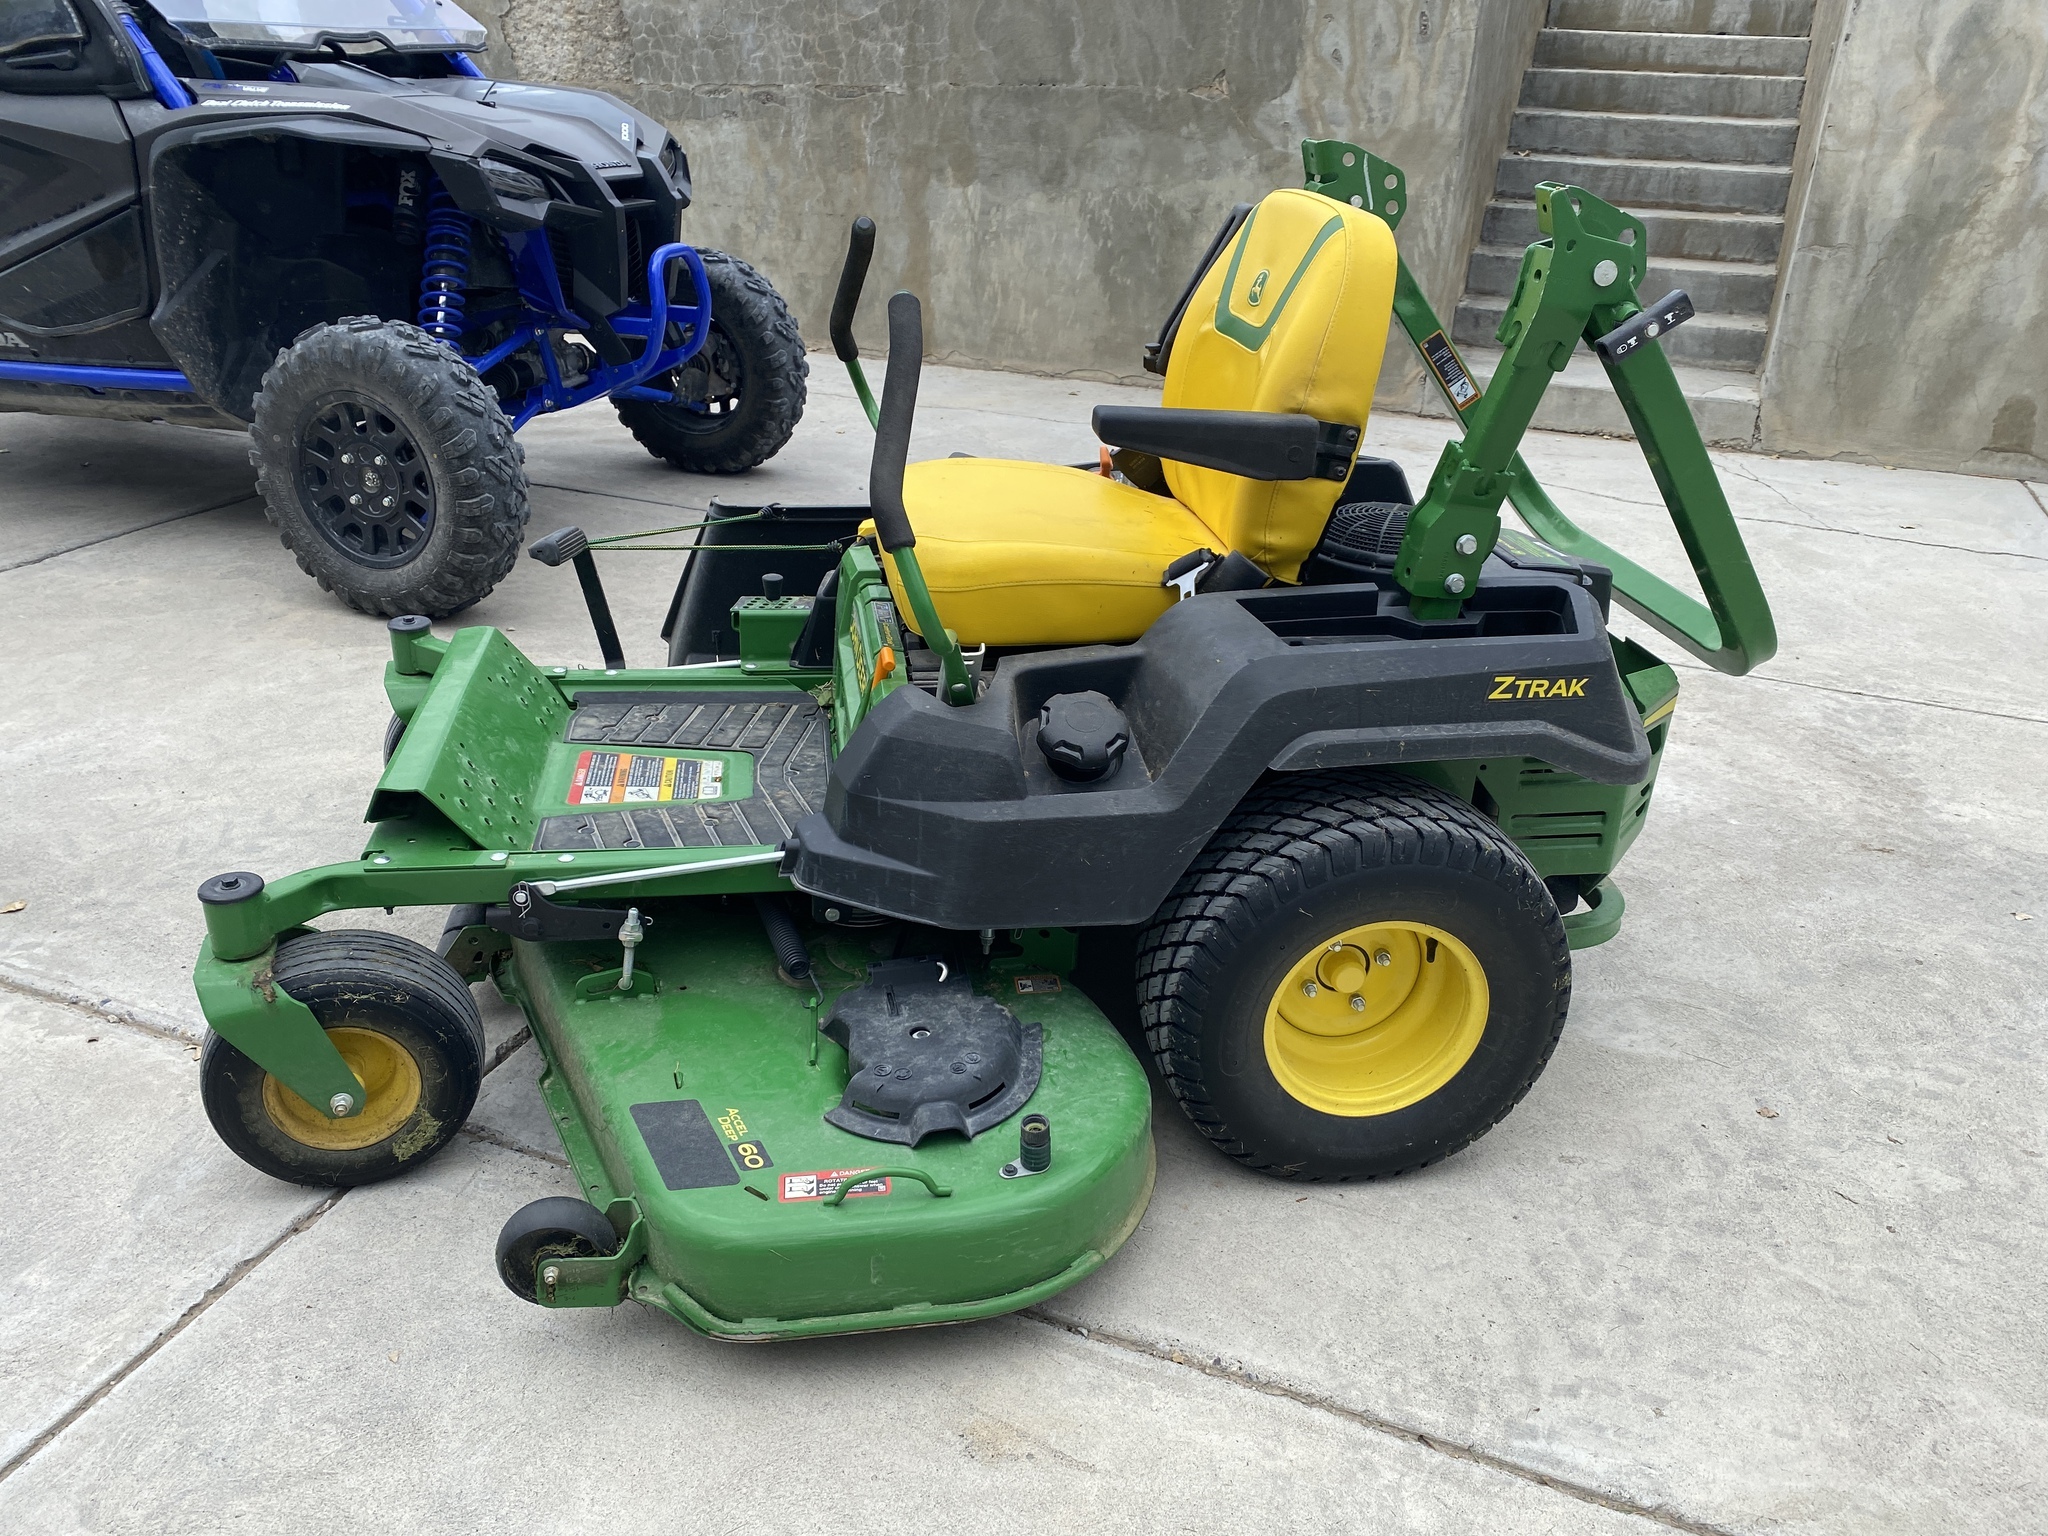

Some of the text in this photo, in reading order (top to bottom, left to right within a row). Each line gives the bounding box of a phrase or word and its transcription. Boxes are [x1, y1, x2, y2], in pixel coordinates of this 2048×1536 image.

[230, 99, 270, 107] Clutch
[269, 100, 352, 110] Transmission
[398, 170, 417, 206] FOX
[1488, 676, 1590, 699] ZTRAK
[718, 1116, 738, 1141] DEEP
[726, 1108, 748, 1136] ACCEL
[738, 1143, 764, 1168] 60
